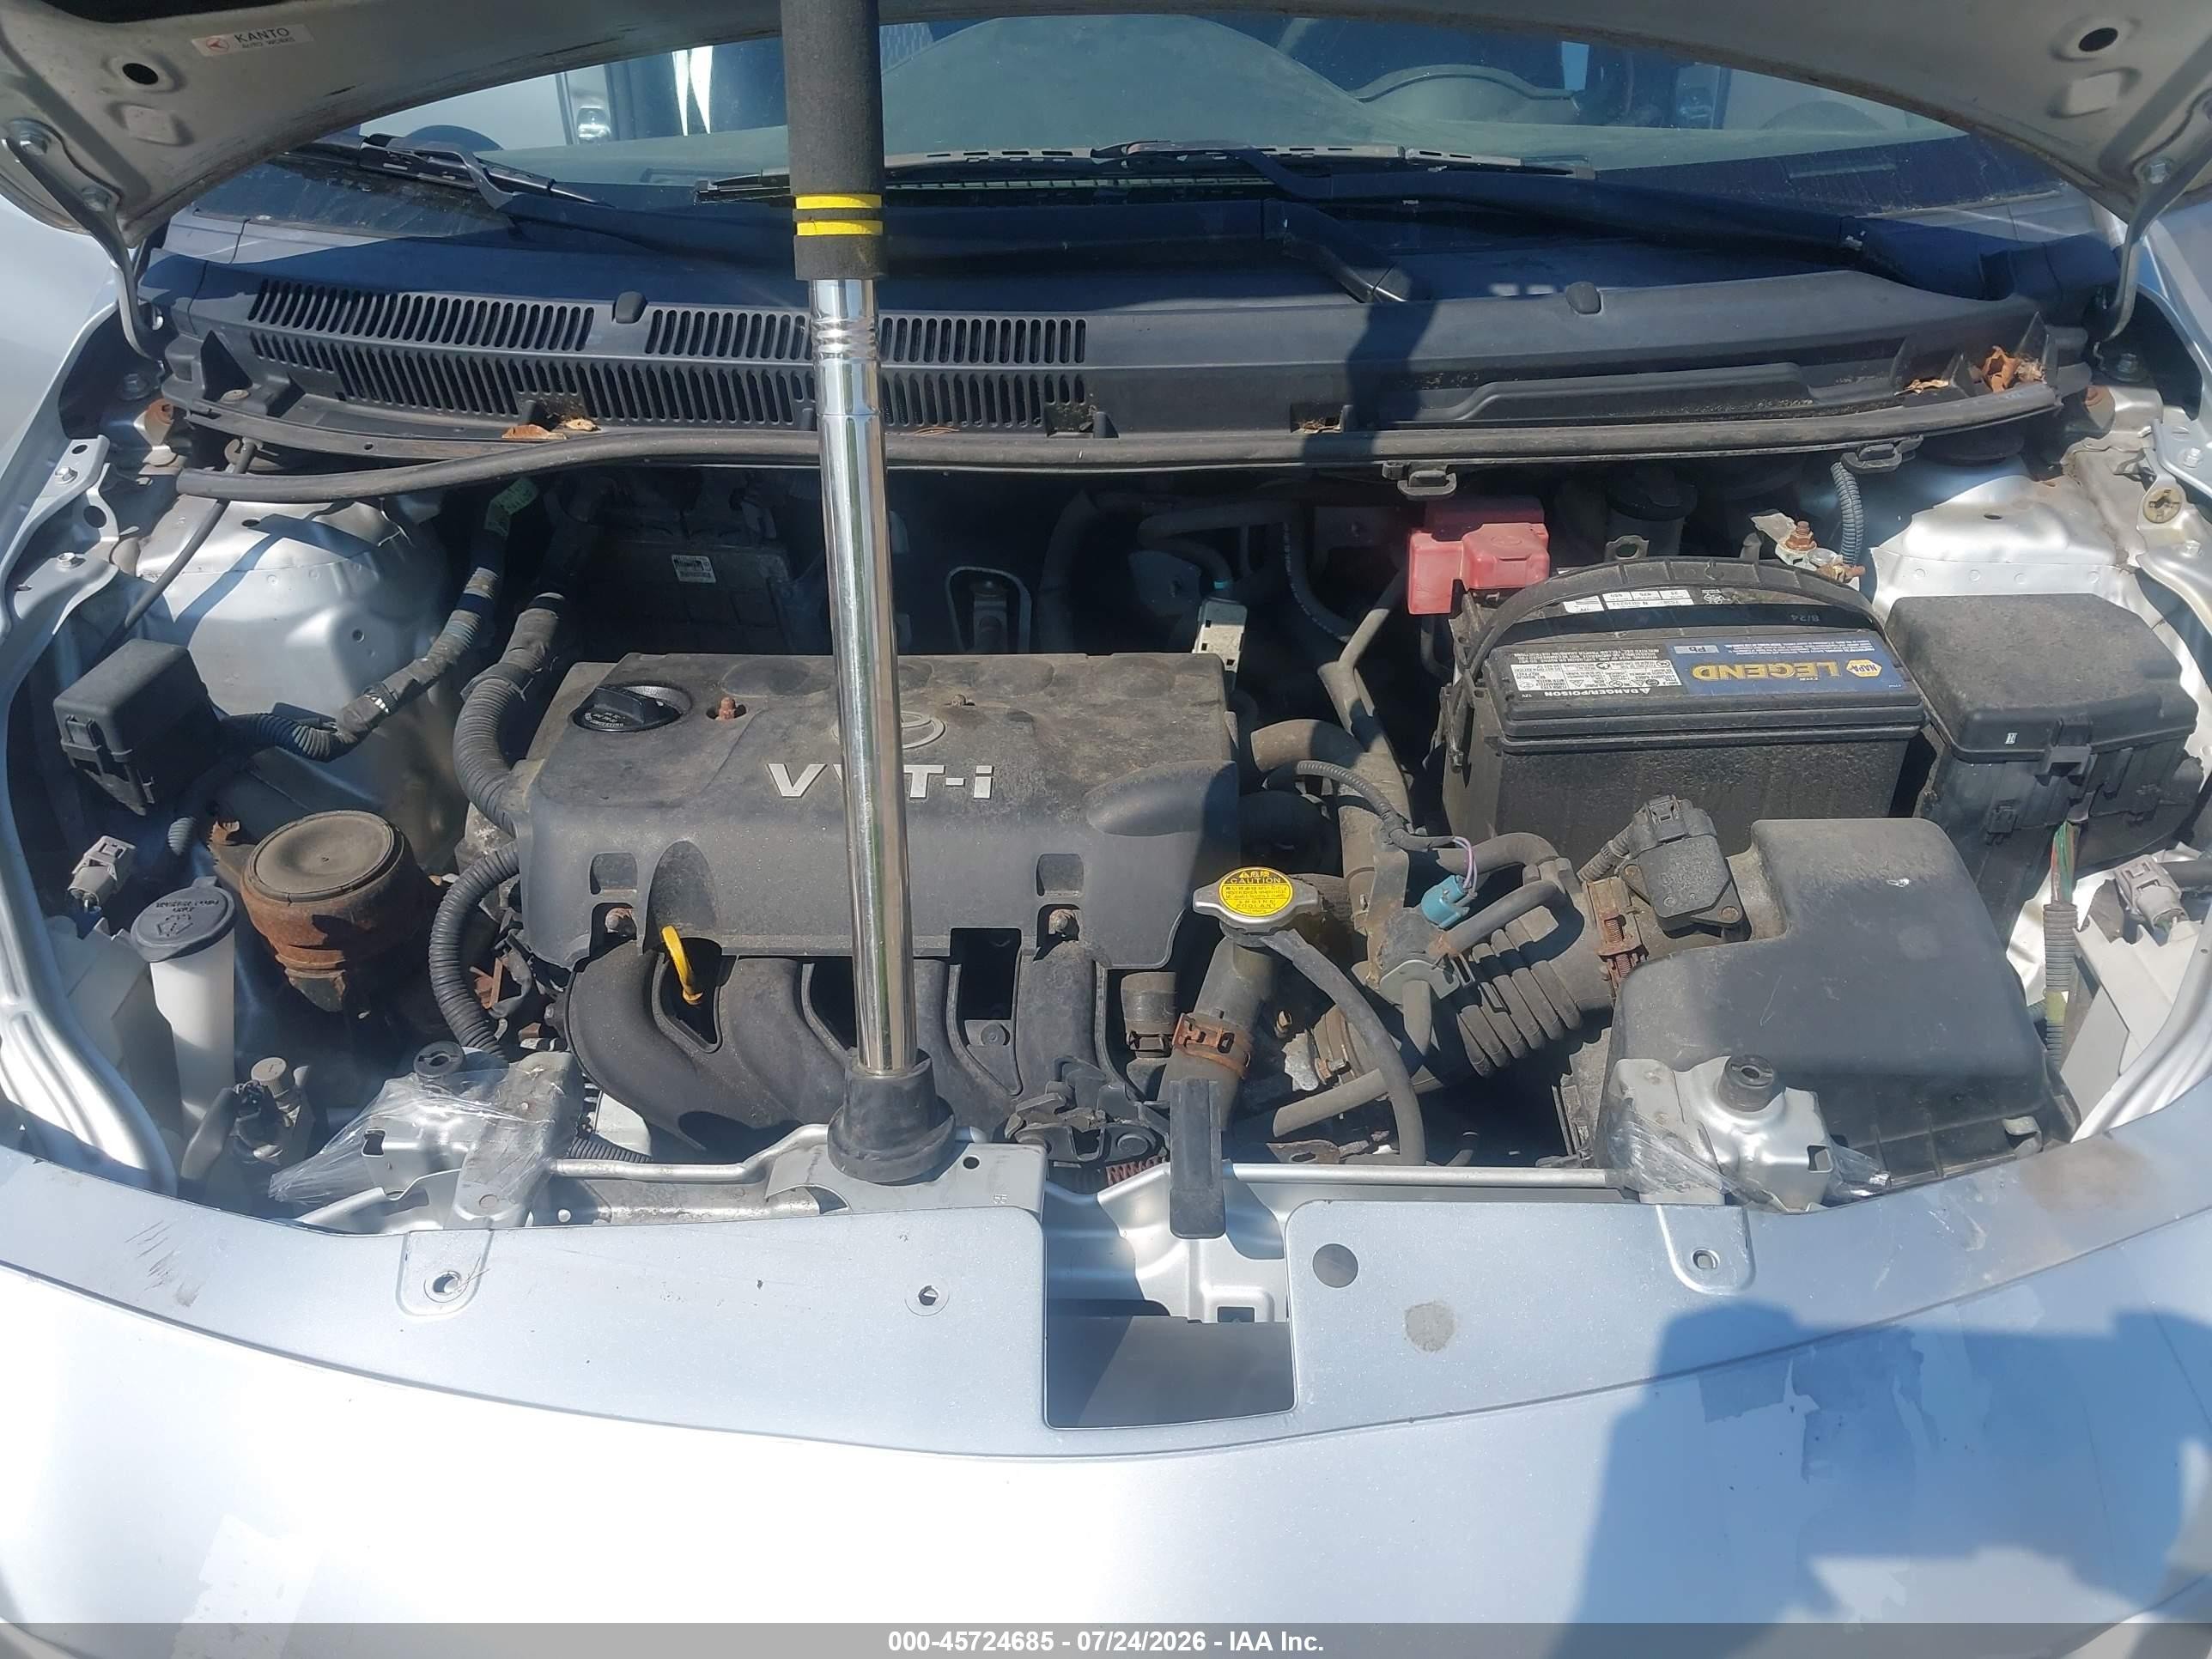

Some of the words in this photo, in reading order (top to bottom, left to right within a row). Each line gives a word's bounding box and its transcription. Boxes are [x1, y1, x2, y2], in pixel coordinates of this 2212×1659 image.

[234, 27, 289, 43] KANTO
[1692, 661, 1841, 681] LEGEND
[1854, 664, 1877, 672] NAPA
[1545, 689, 1640, 697] DANGER/POISON
[767, 763, 993, 799] VT-i
